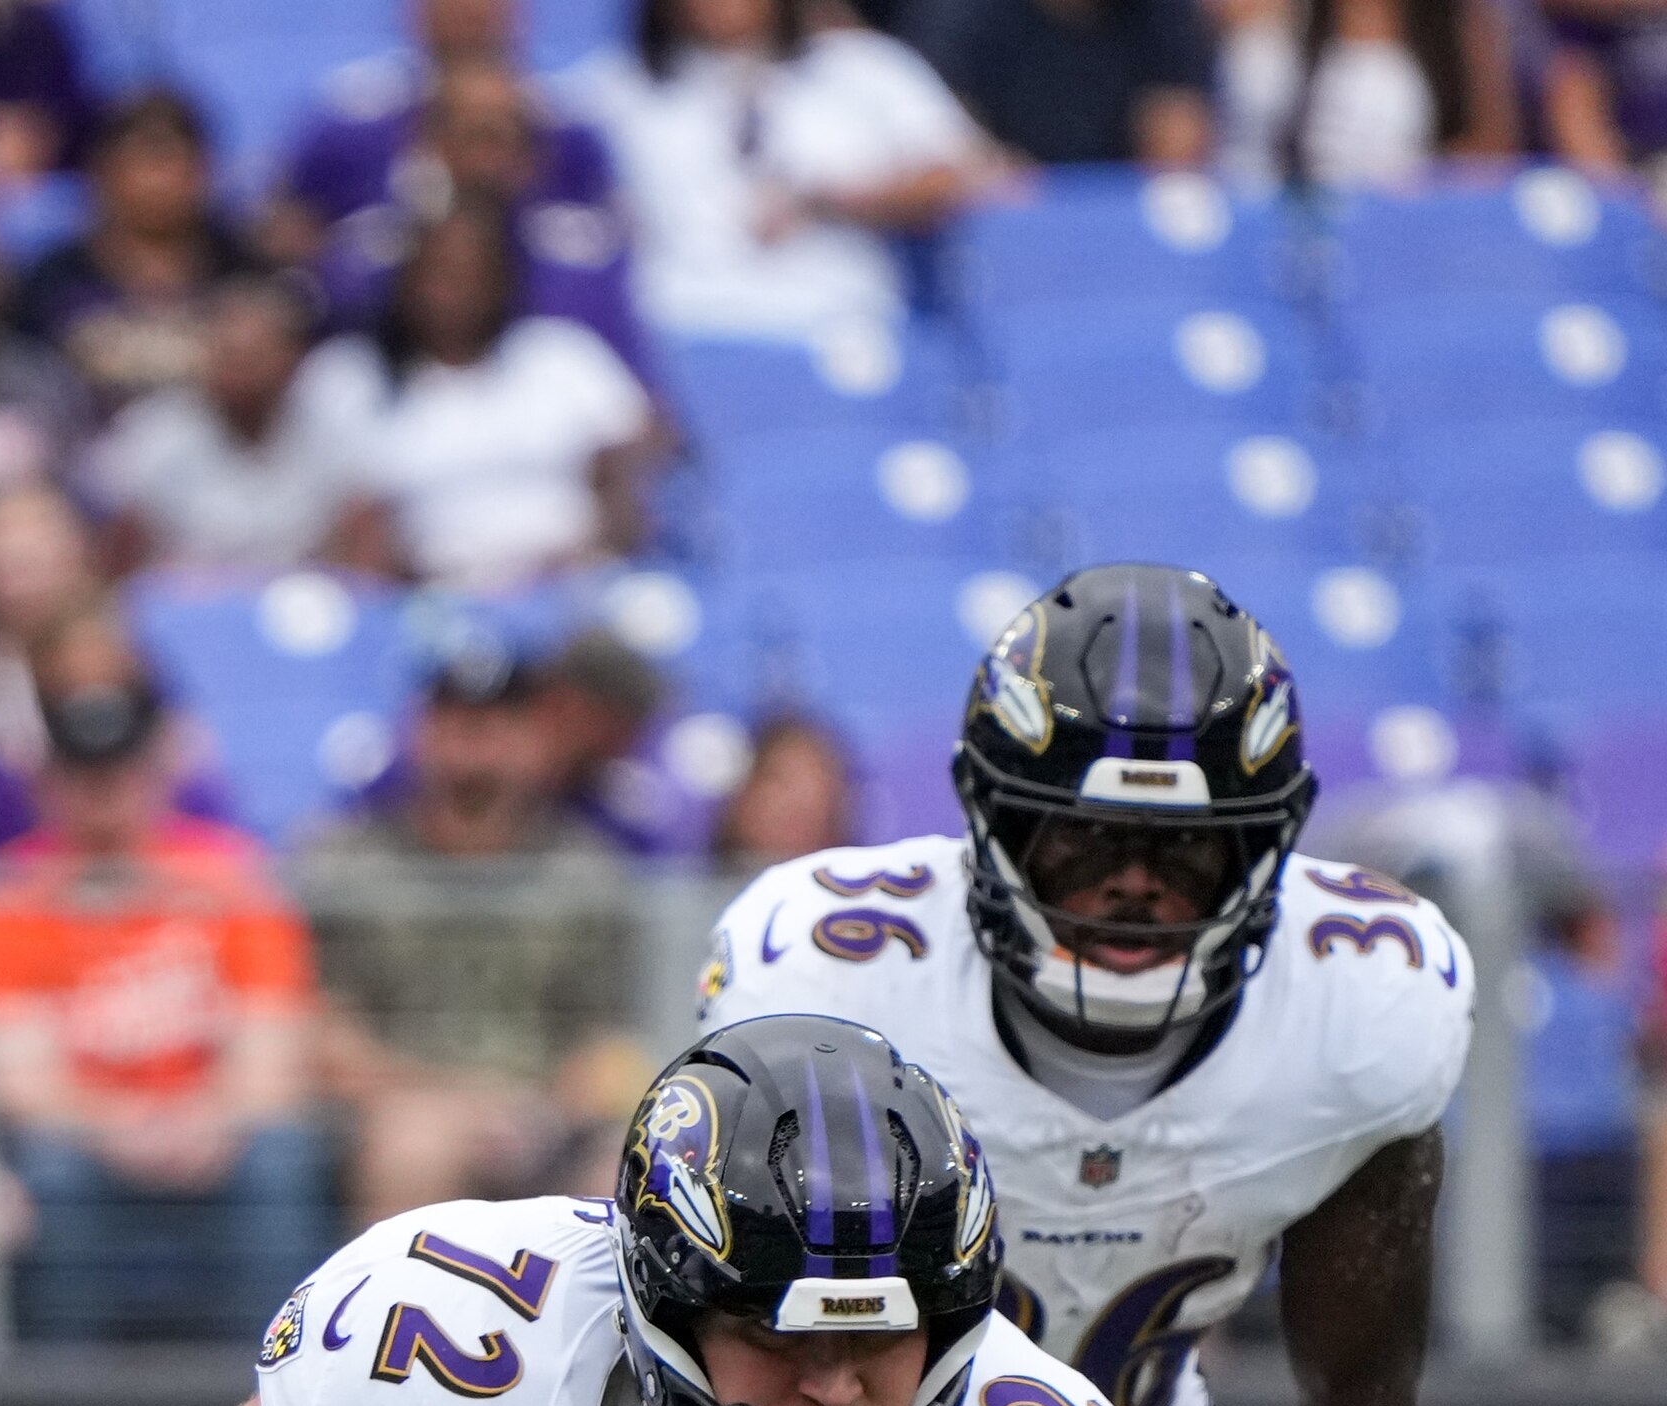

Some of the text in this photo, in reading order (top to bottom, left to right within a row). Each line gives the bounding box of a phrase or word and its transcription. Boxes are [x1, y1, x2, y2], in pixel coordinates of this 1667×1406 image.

[812, 863, 936, 965] 36
[369, 1229, 561, 1399] 72
[820, 1295, 887, 1316] RAVENS
